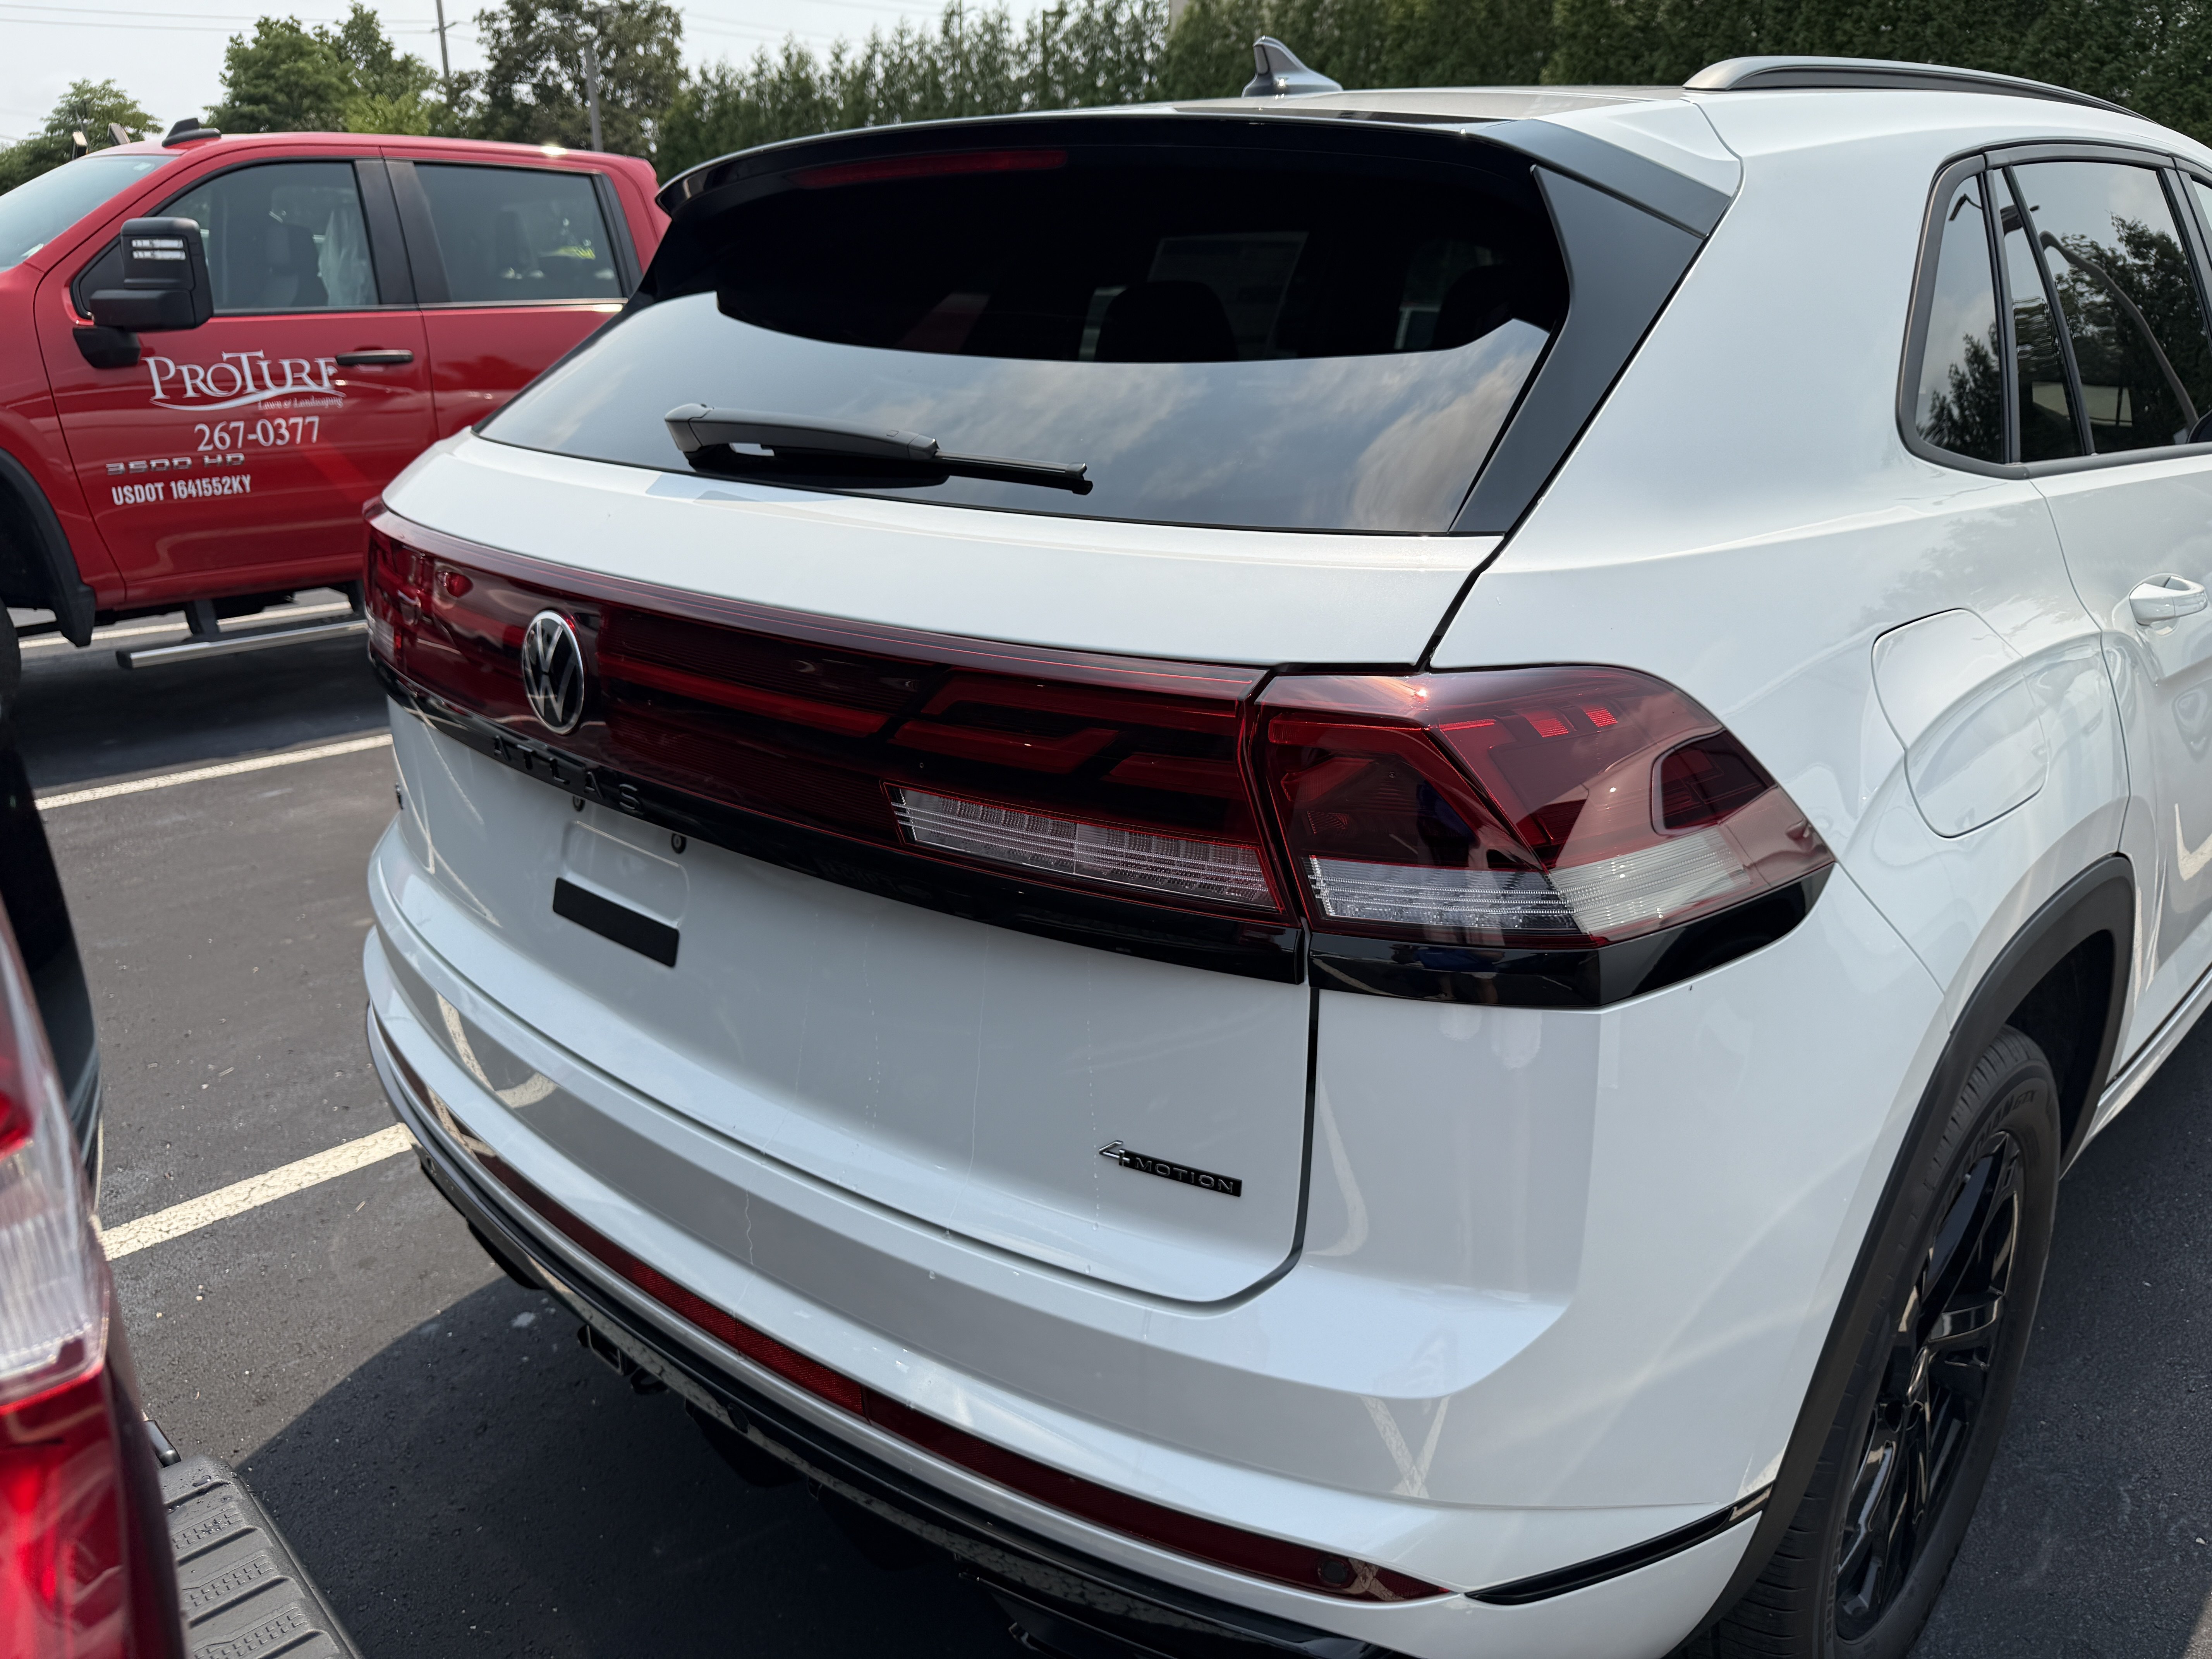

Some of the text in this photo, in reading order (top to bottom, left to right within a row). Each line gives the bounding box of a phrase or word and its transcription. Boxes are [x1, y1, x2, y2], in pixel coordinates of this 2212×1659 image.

[194, 416, 319, 452] 267-0377
[106, 453, 245, 476] 3500 HD
[112, 474, 251, 505] USDOT 1641552KY
[493, 735, 641, 813] ATLAS
[1099, 1140, 1235, 1194] 4MOTION
